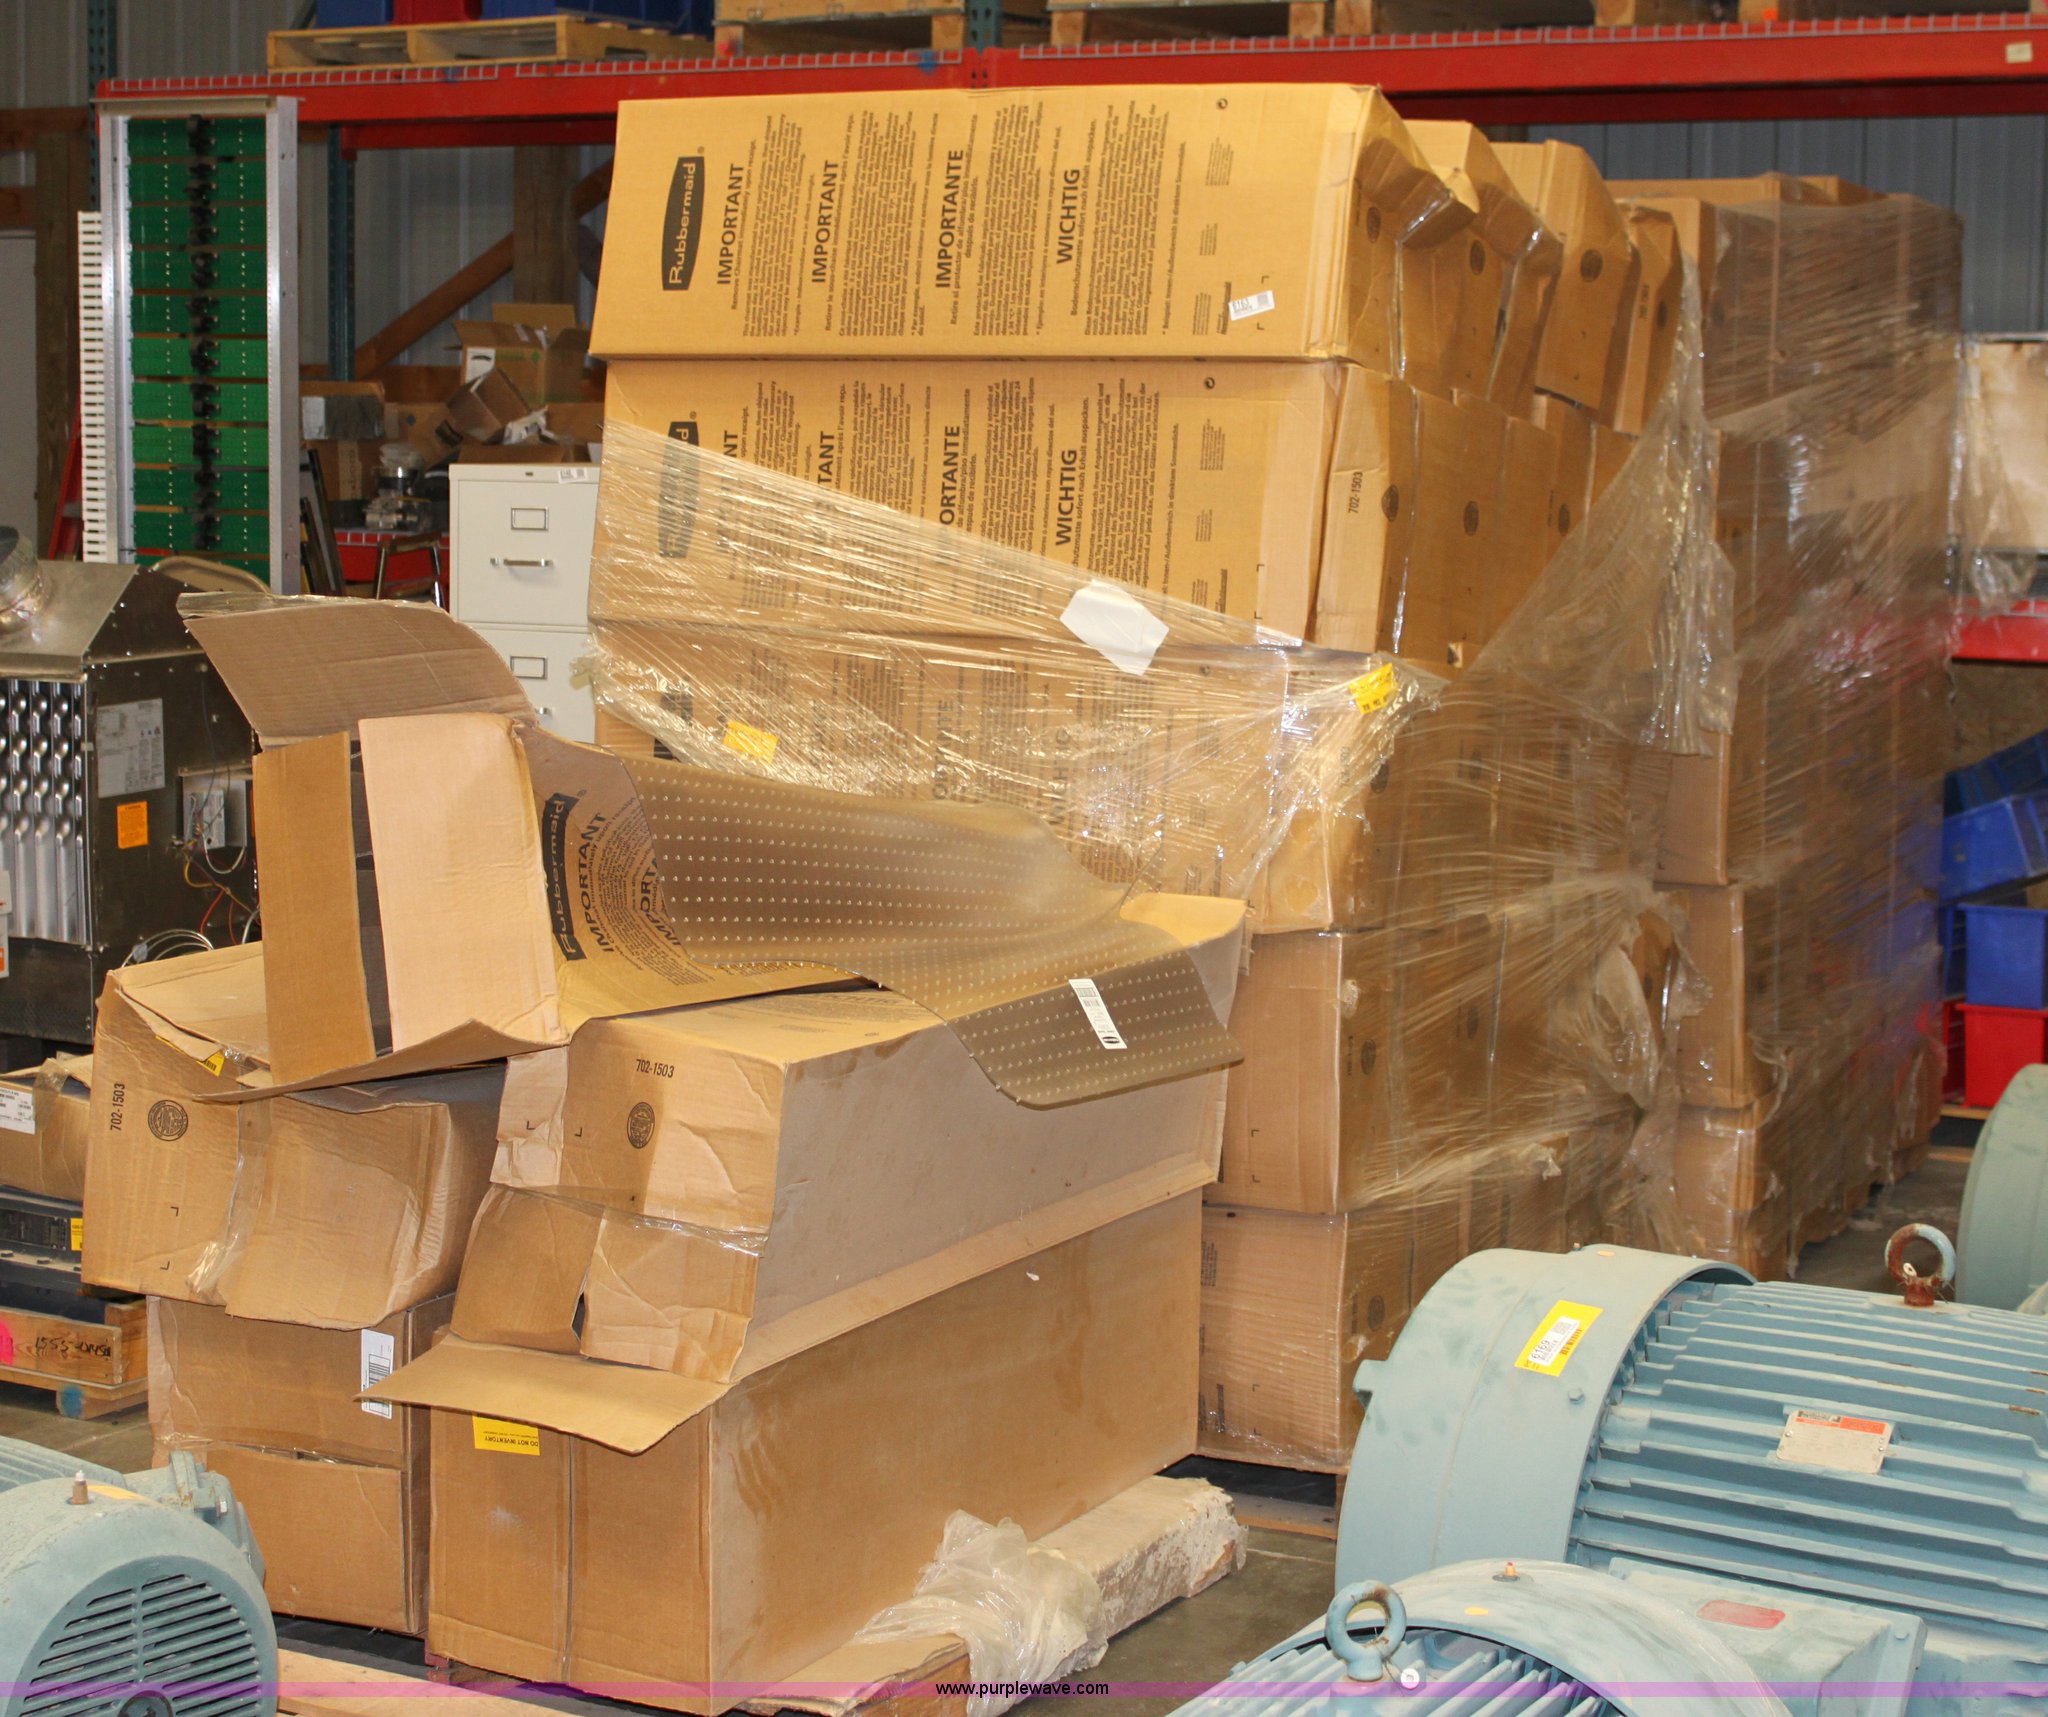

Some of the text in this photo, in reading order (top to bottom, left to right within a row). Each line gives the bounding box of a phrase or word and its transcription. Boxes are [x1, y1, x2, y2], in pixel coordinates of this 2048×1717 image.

[668, 161, 697, 285] Rubbermaid
[716, 162, 744, 284] IMPORTANT
[810, 159, 839, 282] IMPORTANT
[934, 149, 964, 288] IMPORTANTE
[1056, 169, 1080, 264] WICHTIG
[940, 425, 960, 525] ORTANTE
[1056, 449, 1078, 546] WICHTIG
[1348, 471, 1364, 514] 702-1503
[549, 799, 578, 955] Rubbermaid
[578, 811, 615, 953] IMPORTANT
[109, 1083, 126, 1131] 702-1503
[636, 1058, 675, 1078] 702-1503
[485, 1435, 517, 1445] INVENTORY
[517, 1439, 530, 1447] NOT
